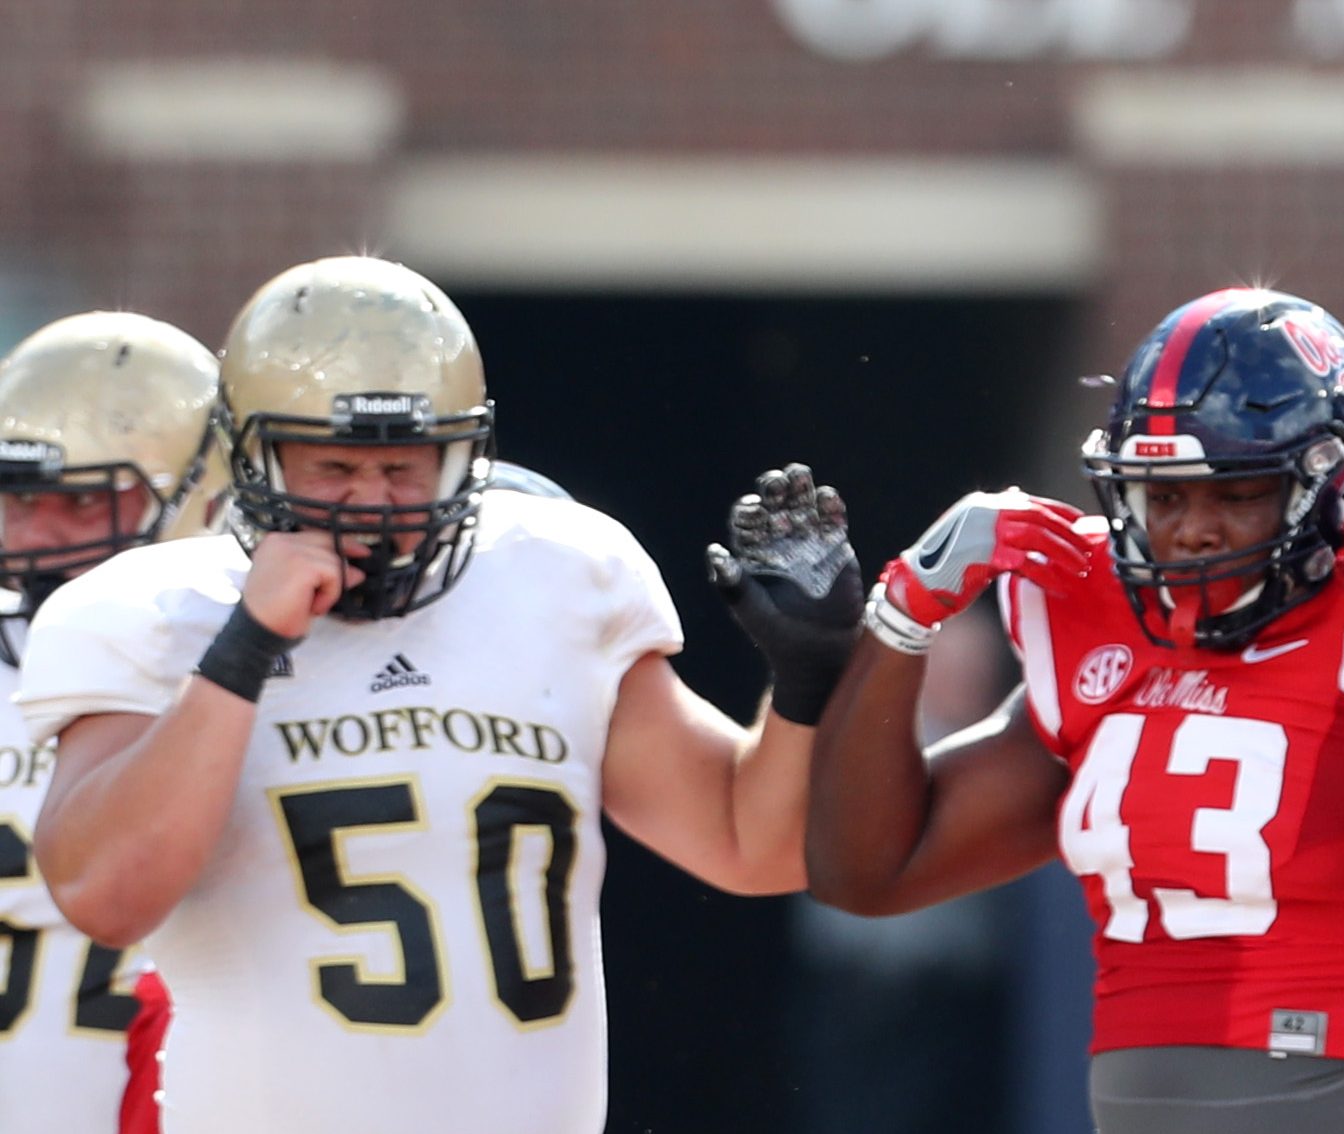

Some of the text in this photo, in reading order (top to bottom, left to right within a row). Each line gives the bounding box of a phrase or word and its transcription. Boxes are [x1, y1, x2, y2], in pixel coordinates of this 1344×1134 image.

[1080, 649, 1129, 697] SEC
[1134, 666, 1229, 715] Ole Miss
[274, 706, 569, 763] WOFFORD
[1058, 712, 1290, 944] 43
[265, 772, 582, 1038] 50
